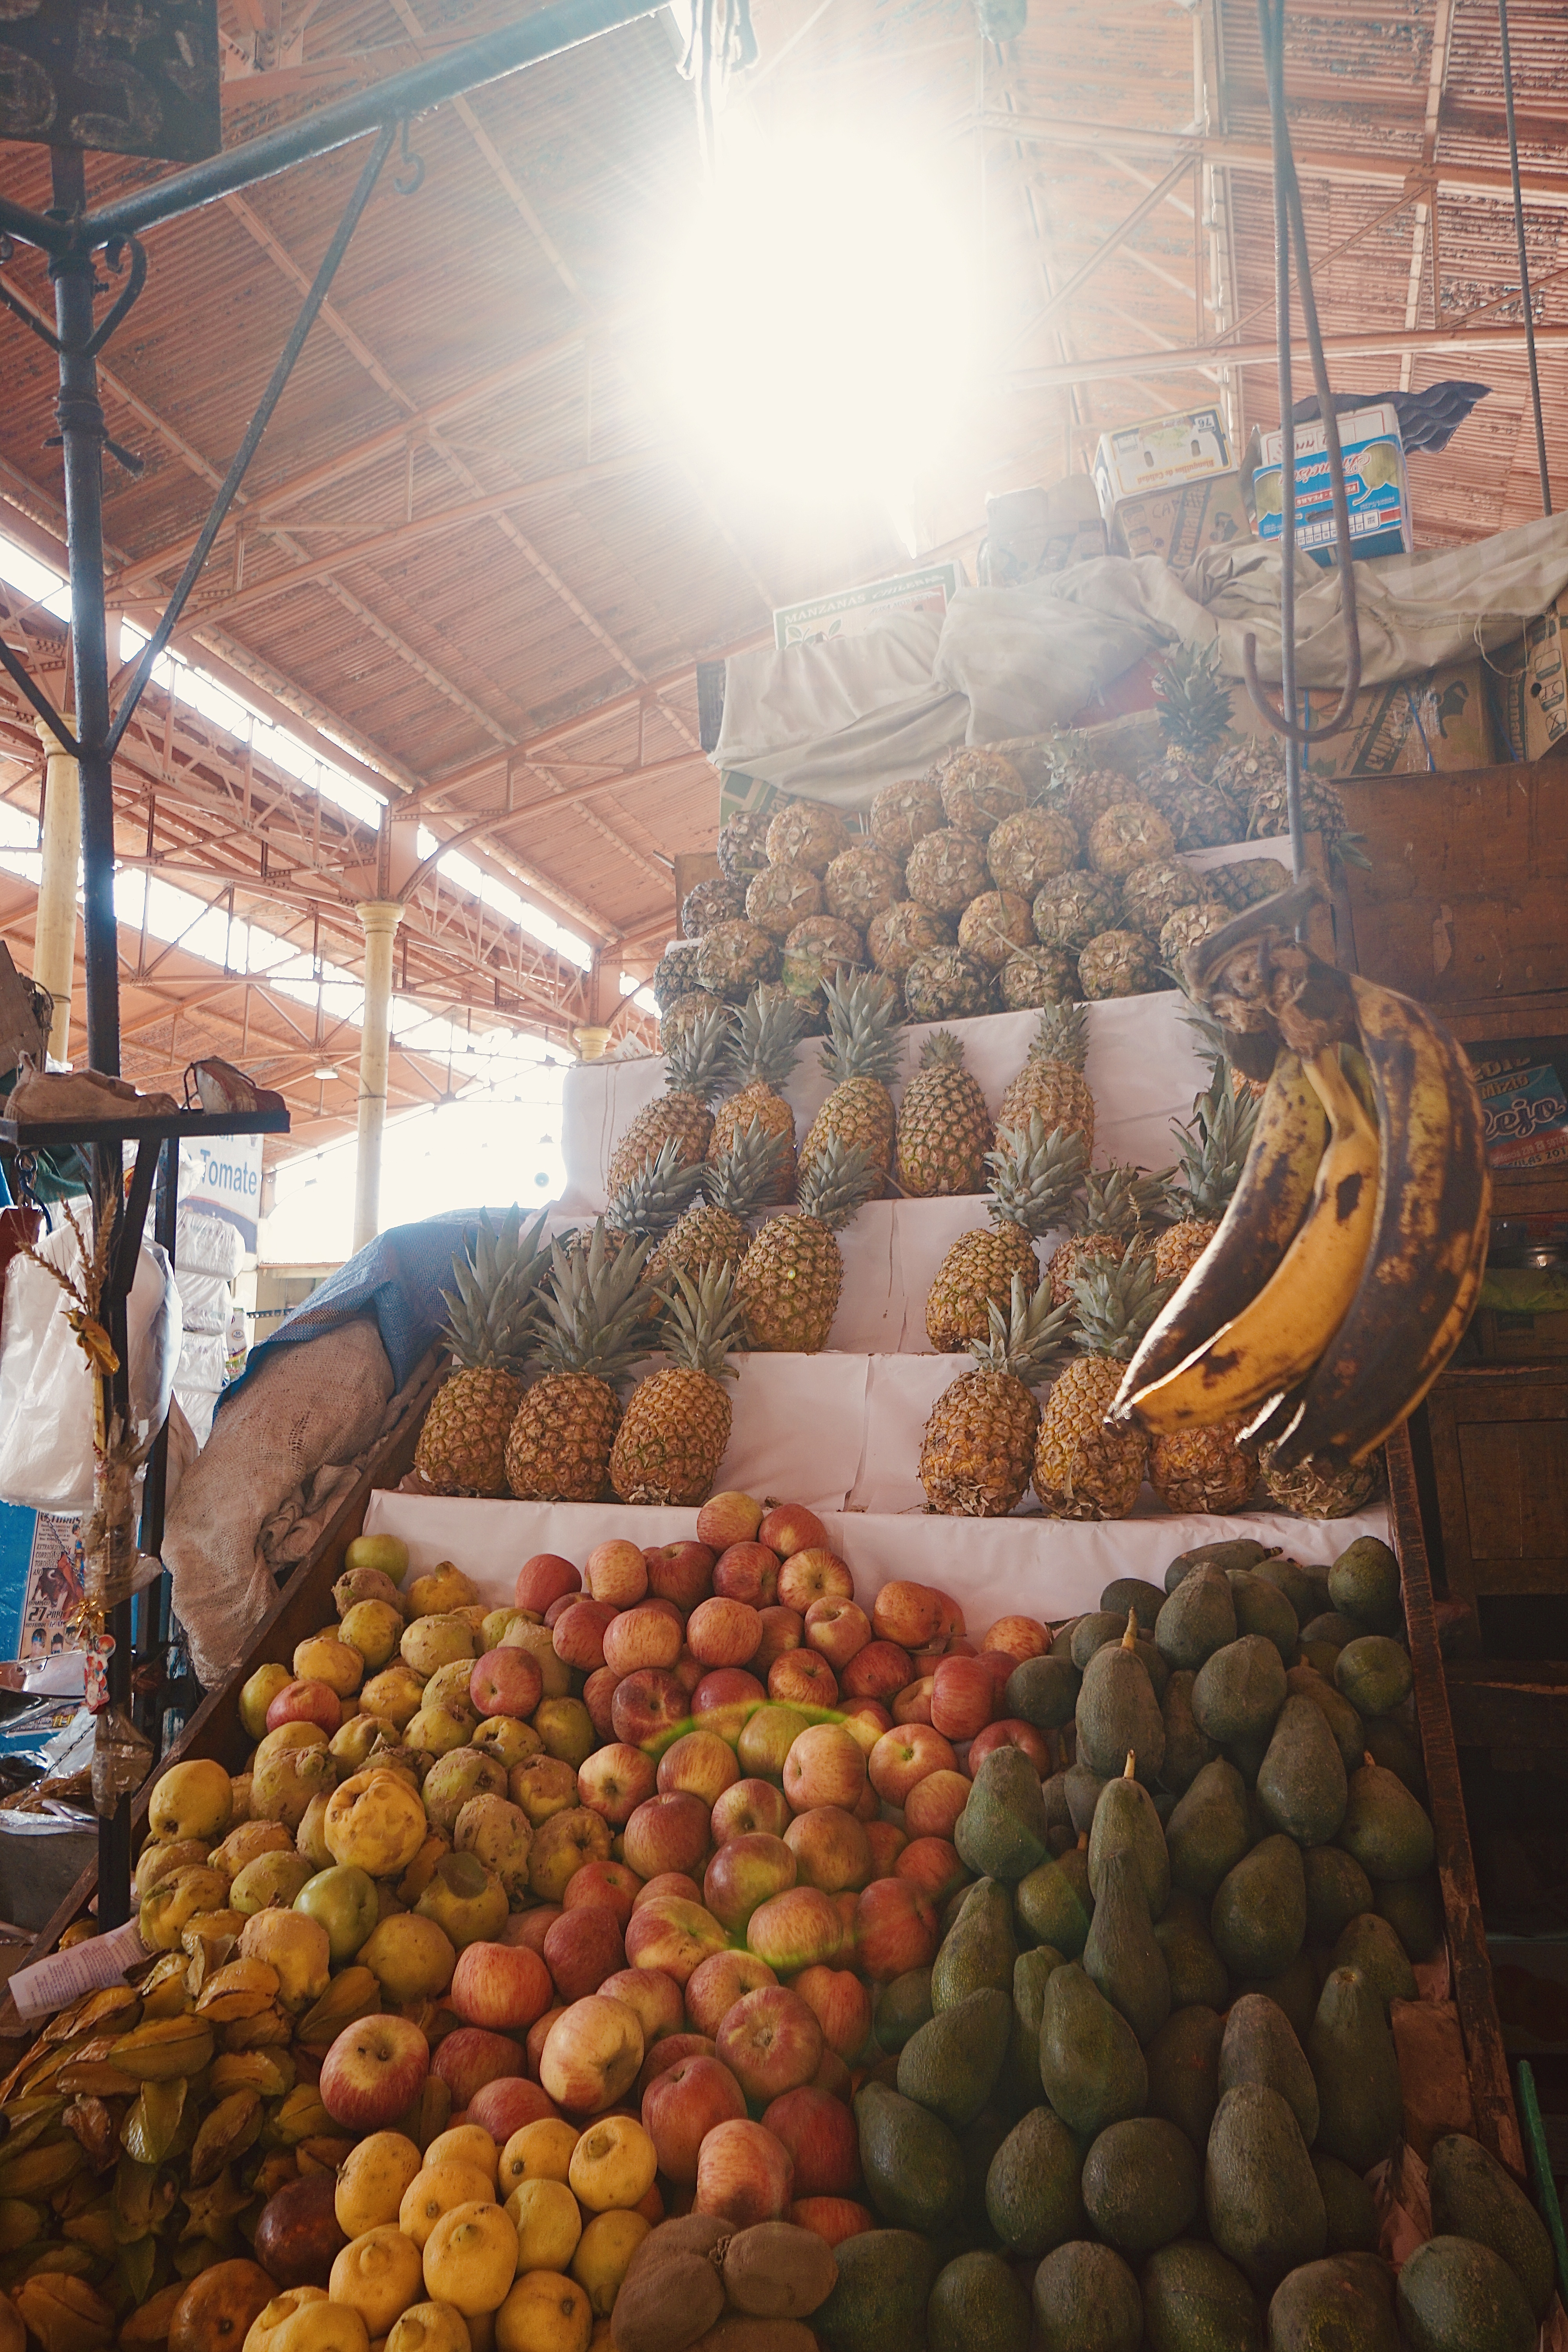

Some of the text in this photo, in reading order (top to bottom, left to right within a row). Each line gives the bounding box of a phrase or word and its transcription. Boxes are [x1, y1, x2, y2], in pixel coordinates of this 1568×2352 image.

[1279, 453, 1371, 485] Frncis
[784, 593, 866, 624] MANZANAS
[200, 1149, 258, 1196] Tomate
[28, 1607, 47, 1621] 27
